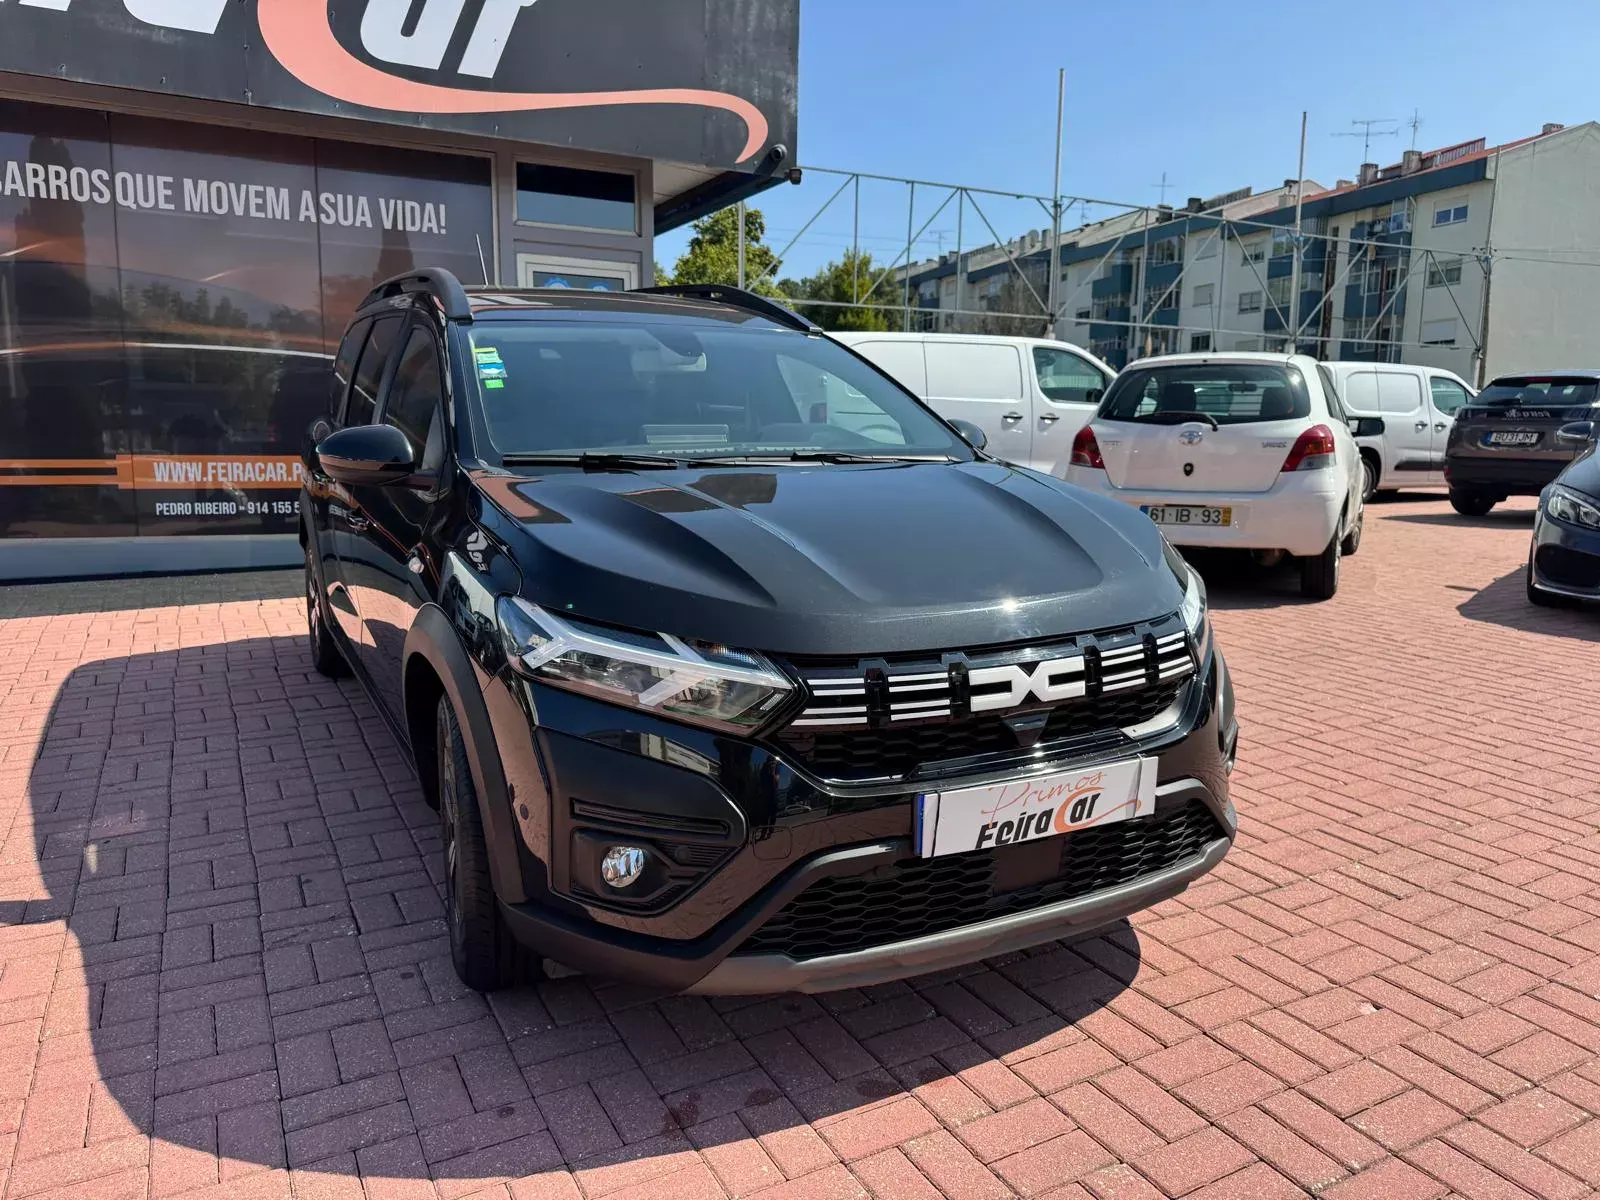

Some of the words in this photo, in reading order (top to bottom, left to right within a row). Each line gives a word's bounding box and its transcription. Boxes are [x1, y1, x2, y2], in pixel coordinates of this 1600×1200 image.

[0, 160, 111, 204] ARROS
[115, 171, 176, 209] QUE
[183, 178, 290, 221] MOVEM
[299, 190, 317, 223] A
[319, 192, 373, 228] SUA
[379, 198, 447, 234] VIDA!
[153, 461, 302, 483] WWW.FEIRACAR.P
[156, 502, 192, 515] PEDRO
[194, 501, 237, 515] RIBEIRO
[247, 501, 269, 514] 914
[272, 501, 292, 514] 155
